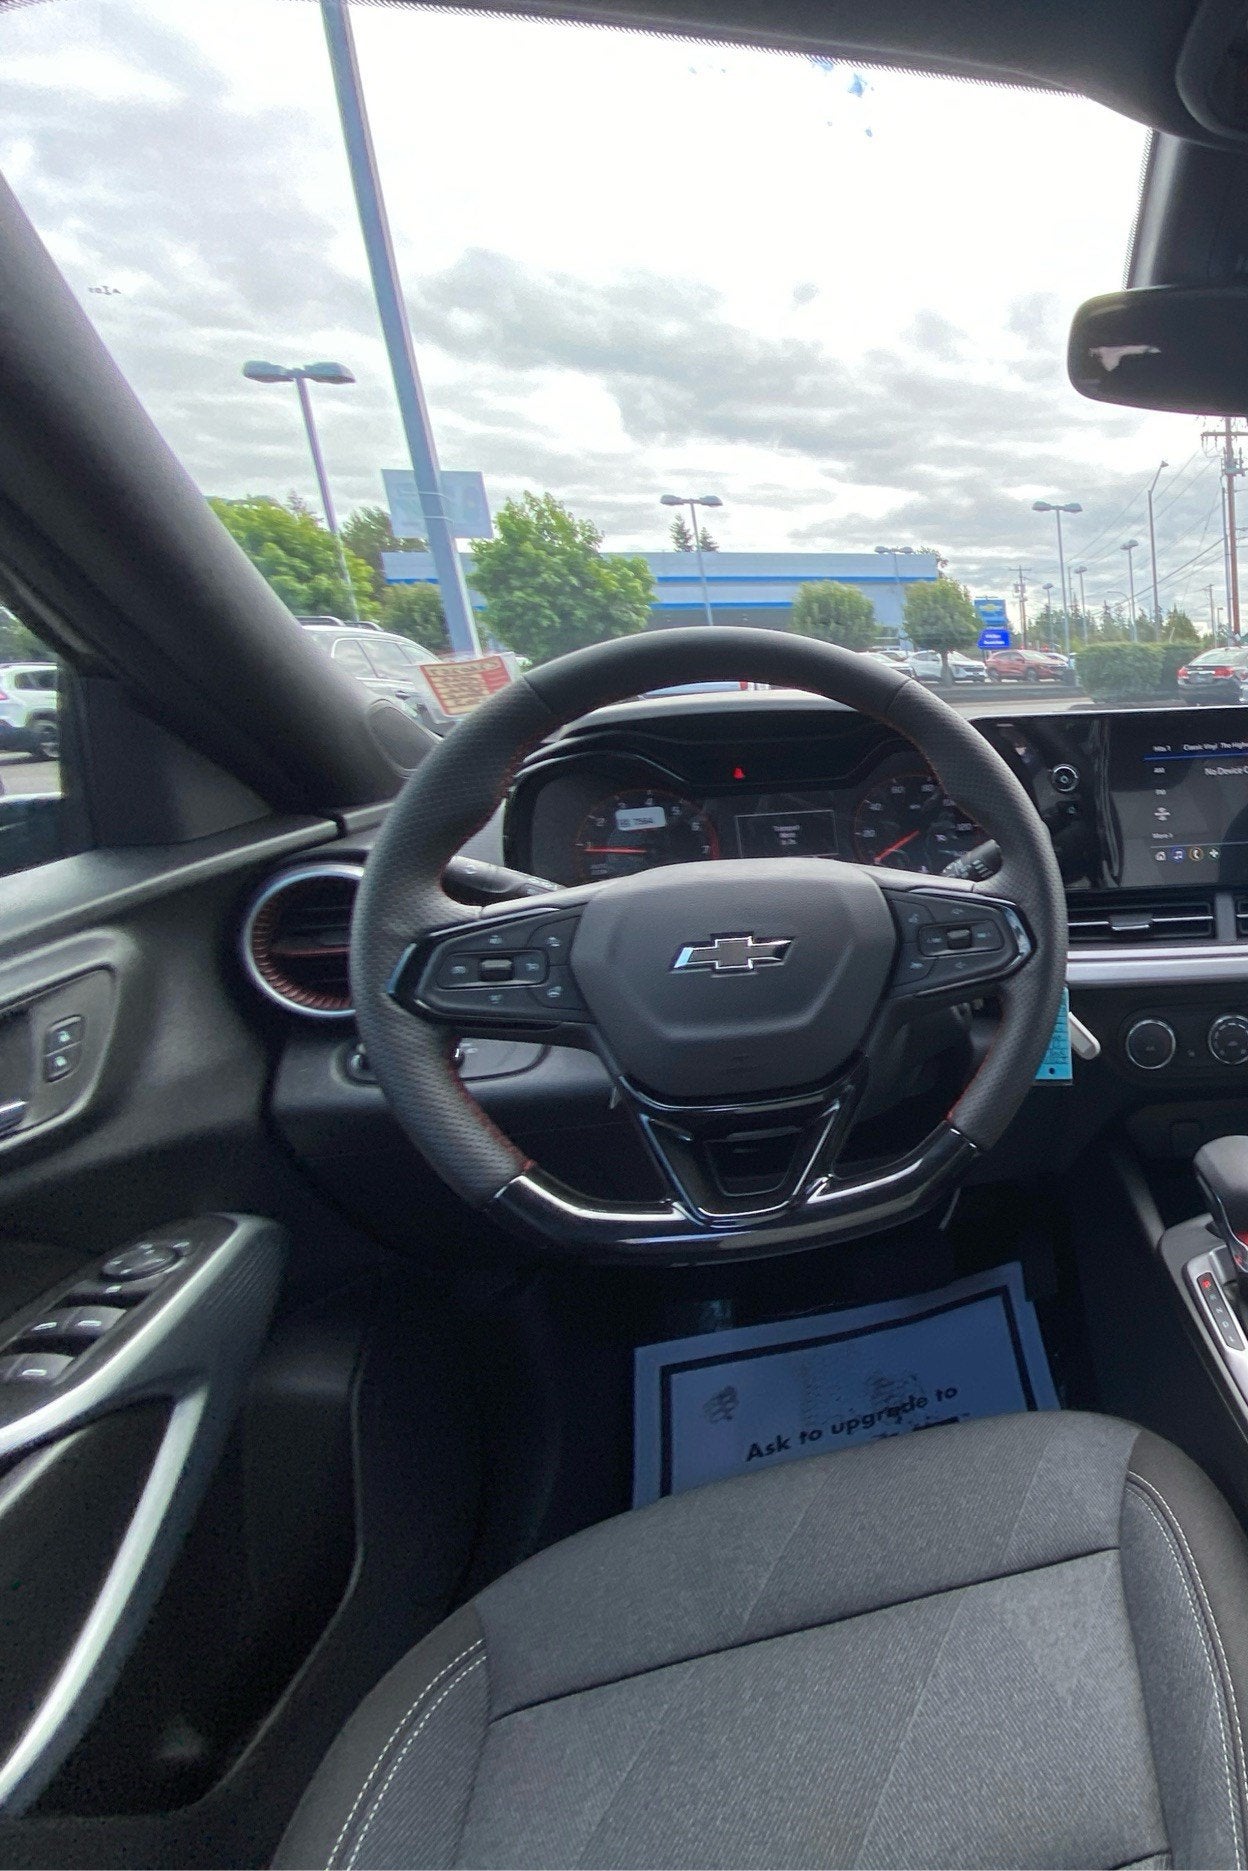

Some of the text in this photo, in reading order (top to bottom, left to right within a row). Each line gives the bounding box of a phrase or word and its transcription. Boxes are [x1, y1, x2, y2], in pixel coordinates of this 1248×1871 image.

[1220, 741, 1232, 749] The
[1204, 767, 1217, 776] No
[1217, 766, 1243, 775] Device
[745, 1434, 792, 1463] Ask
[799, 1428, 823, 1445] to
[831, 1393, 929, 1436] upgrade
[934, 1386, 958, 1402] to
